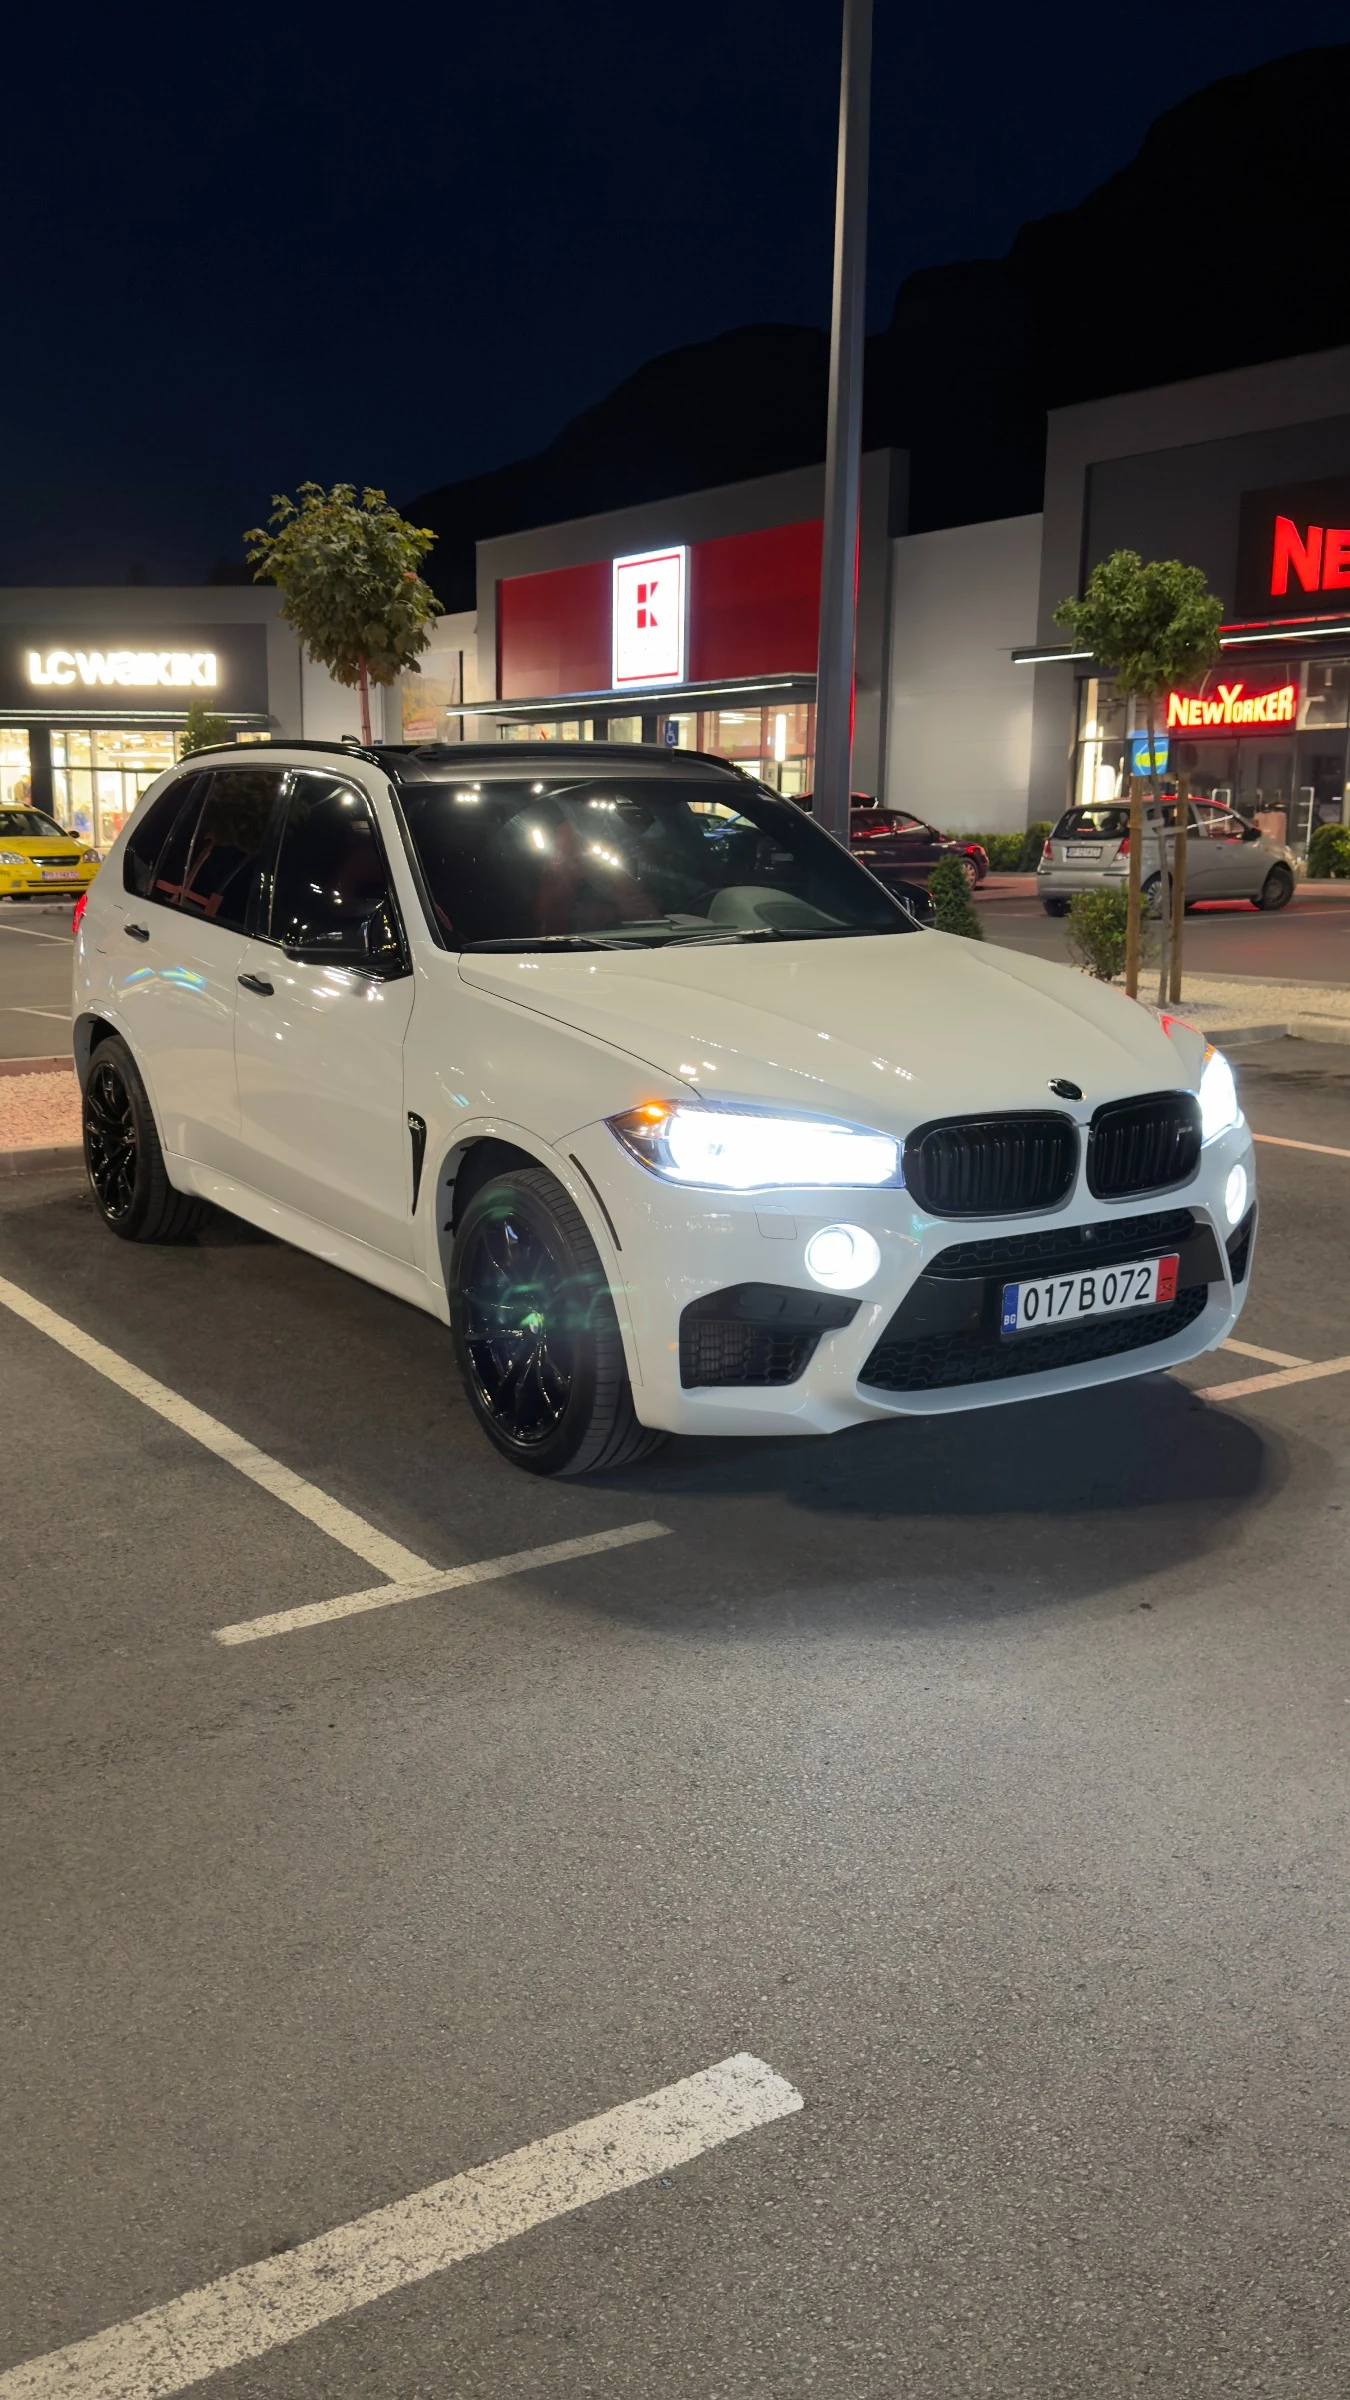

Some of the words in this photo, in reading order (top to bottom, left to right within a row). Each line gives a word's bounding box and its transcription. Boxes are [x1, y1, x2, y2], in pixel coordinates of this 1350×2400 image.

[636, 581, 659, 629] K
[1023, 1267, 1152, 1321] 017B072
[1003, 1313, 1017, 1326] BG
